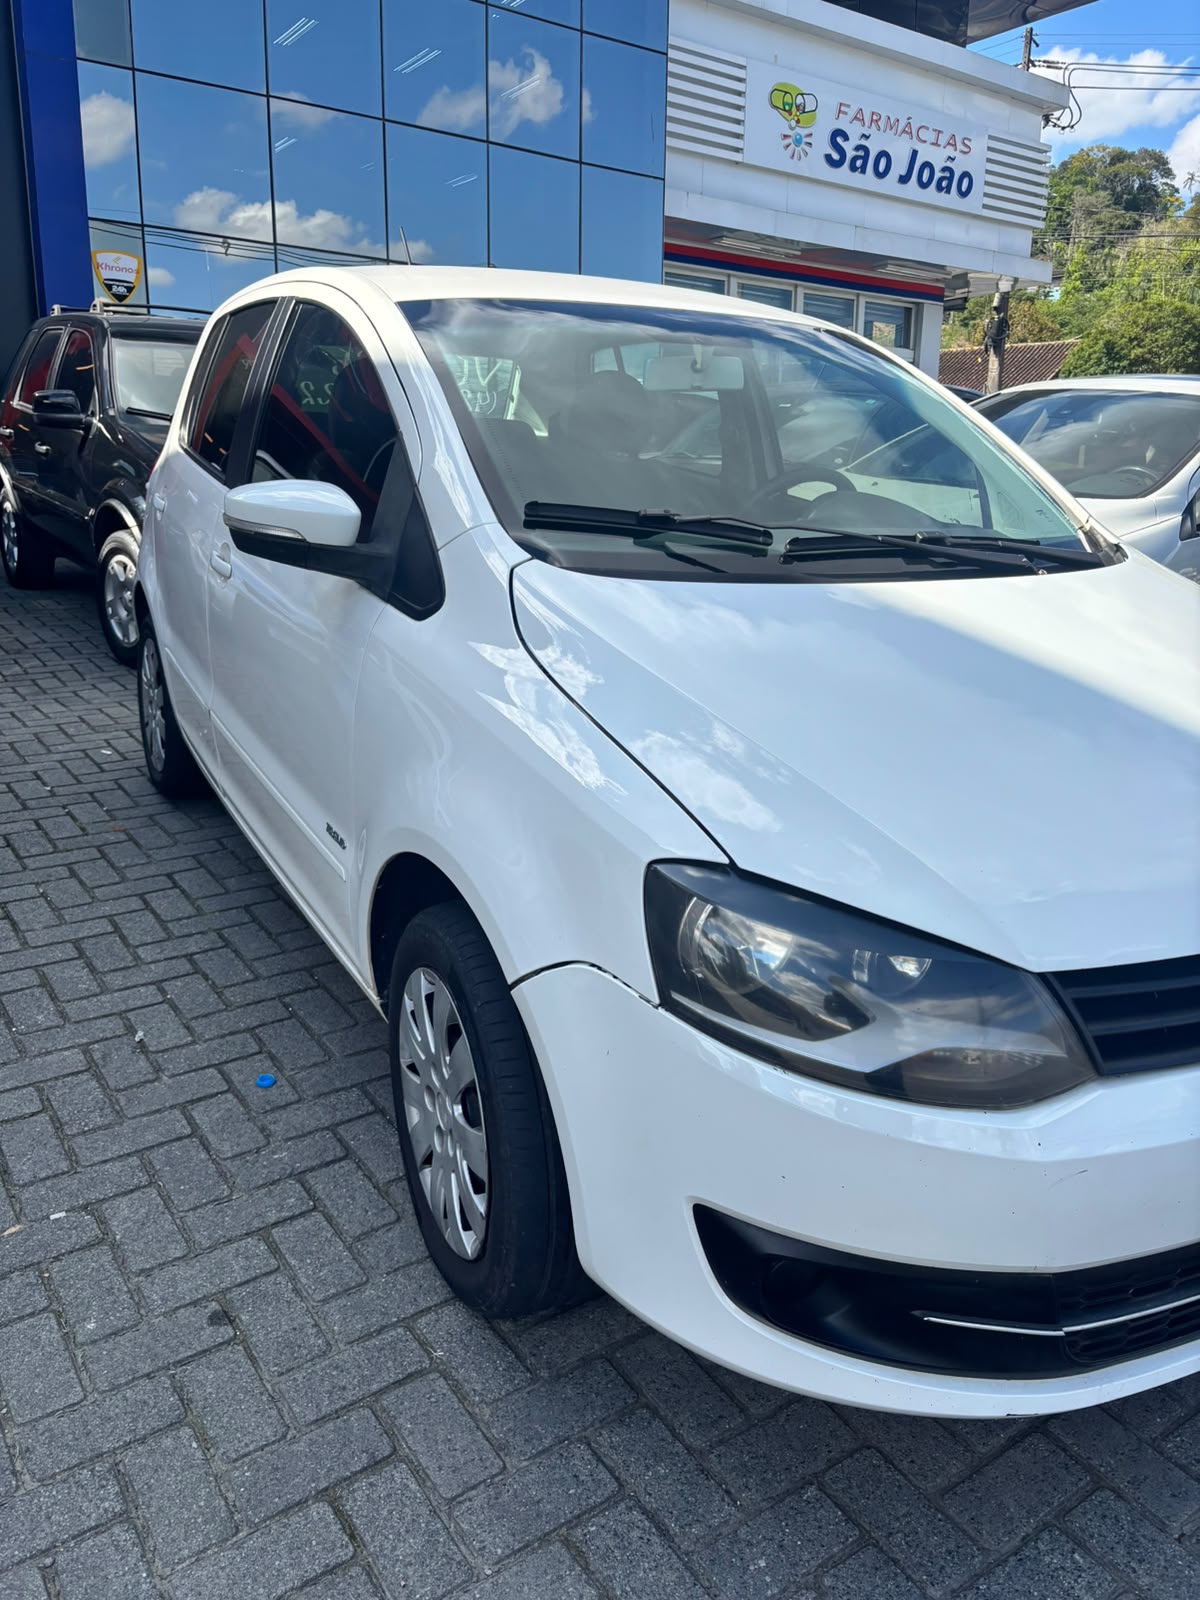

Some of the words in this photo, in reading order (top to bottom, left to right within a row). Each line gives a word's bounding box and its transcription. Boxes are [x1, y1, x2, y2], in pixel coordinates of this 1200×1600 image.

[835, 102, 973, 155] FARMÁCIAS
[824, 128, 892, 179] São
[897, 147, 974, 199] João
[96, 262, 139, 274] Khronos
